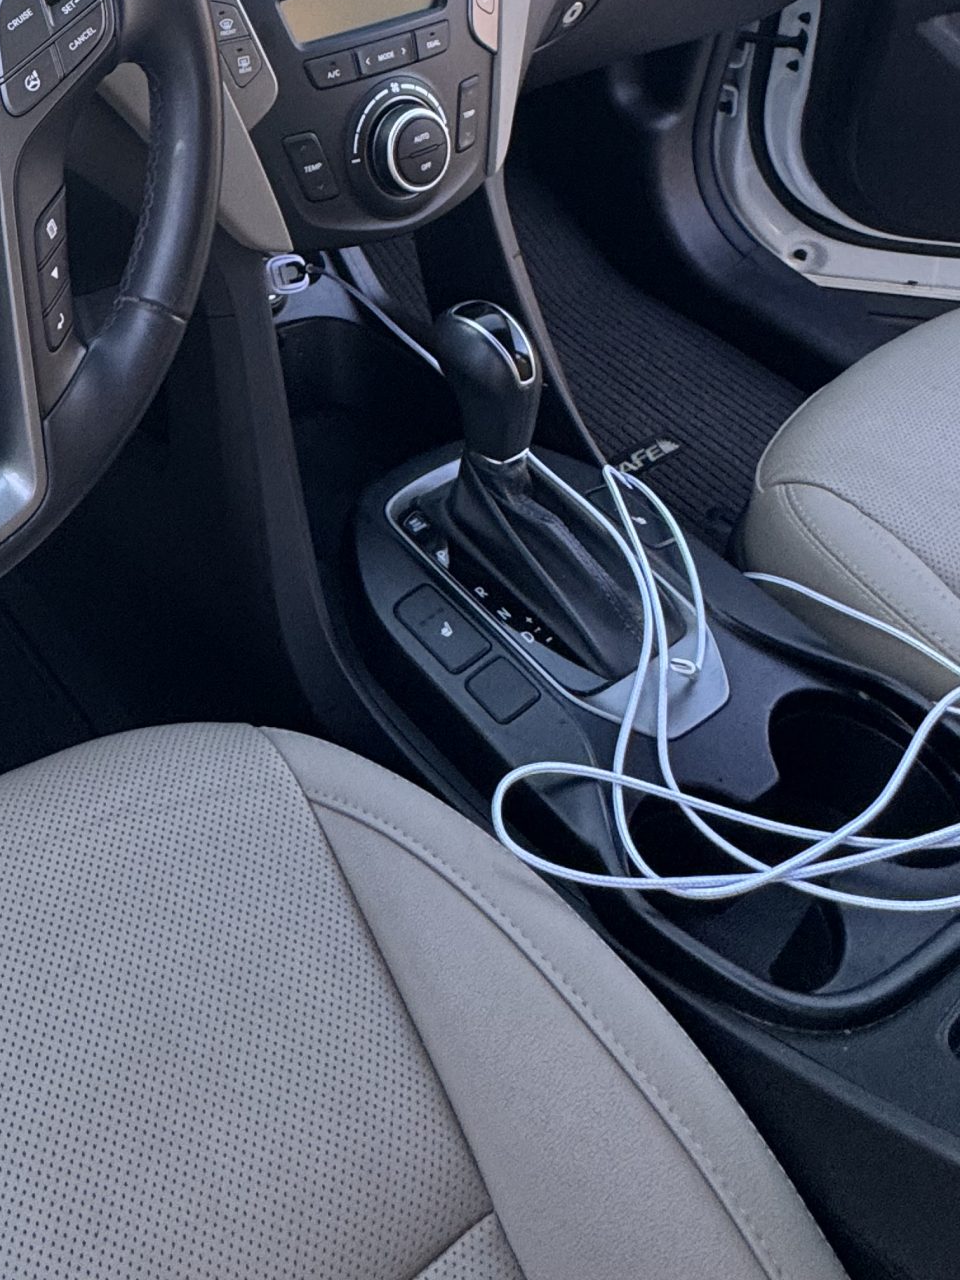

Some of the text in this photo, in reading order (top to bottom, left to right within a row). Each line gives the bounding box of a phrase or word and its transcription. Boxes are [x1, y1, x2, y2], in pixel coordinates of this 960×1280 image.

[7, 8, 34, 31] CRUISE
[68, 27, 97, 51] CANCEL
[377, 51, 395, 62] MODE
[327, 69, 341, 79] A/C
[303, 162, 323, 174] TEMP
[619, 444, 665, 473] AFE
[473, 585, 489, 599] R
[496, 606, 512, 621] N
[520, 630, 536, 644] D
